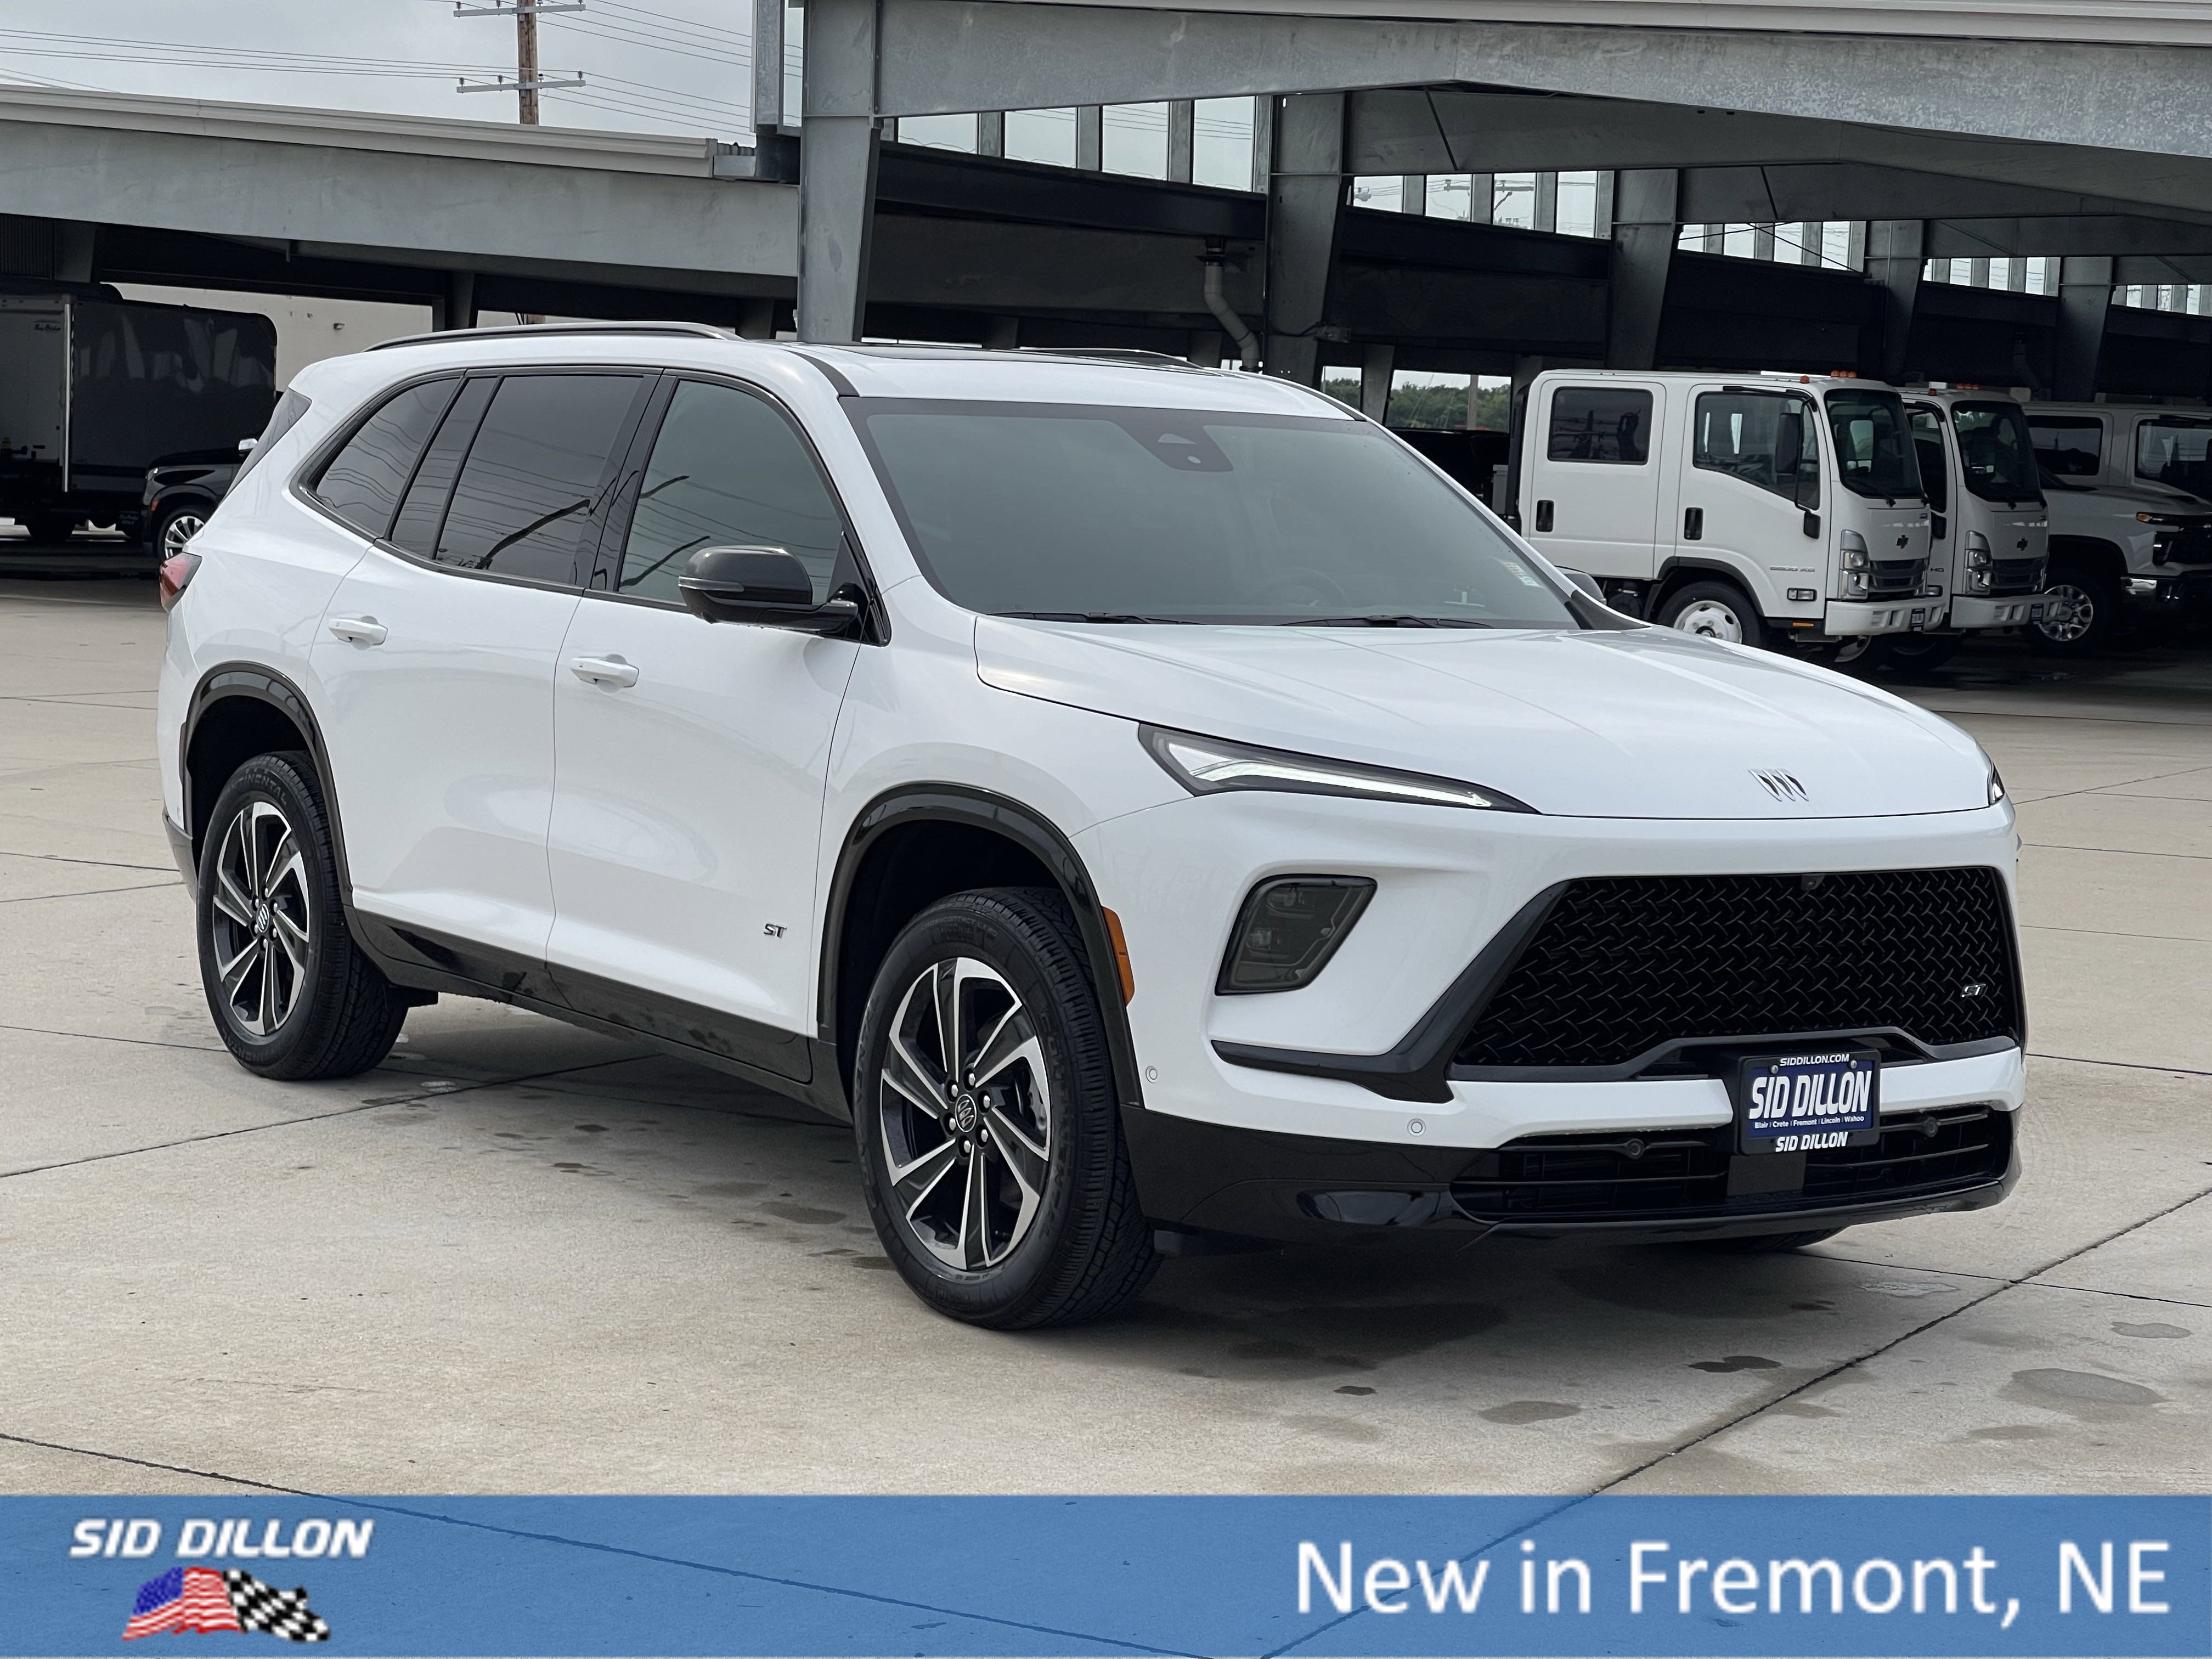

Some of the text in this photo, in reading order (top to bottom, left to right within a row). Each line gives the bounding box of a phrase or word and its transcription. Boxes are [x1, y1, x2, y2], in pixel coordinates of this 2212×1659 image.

[763, 923, 787, 939] ST
[1961, 984, 1987, 997] ST
[1780, 1053, 1849, 1067] SIDDILLON.COM
[1748, 1070, 1872, 1120] SID DILLON
[1820, 1116, 1841, 1125] Lincoln
[1775, 1131, 1848, 1152] SID DILLON
